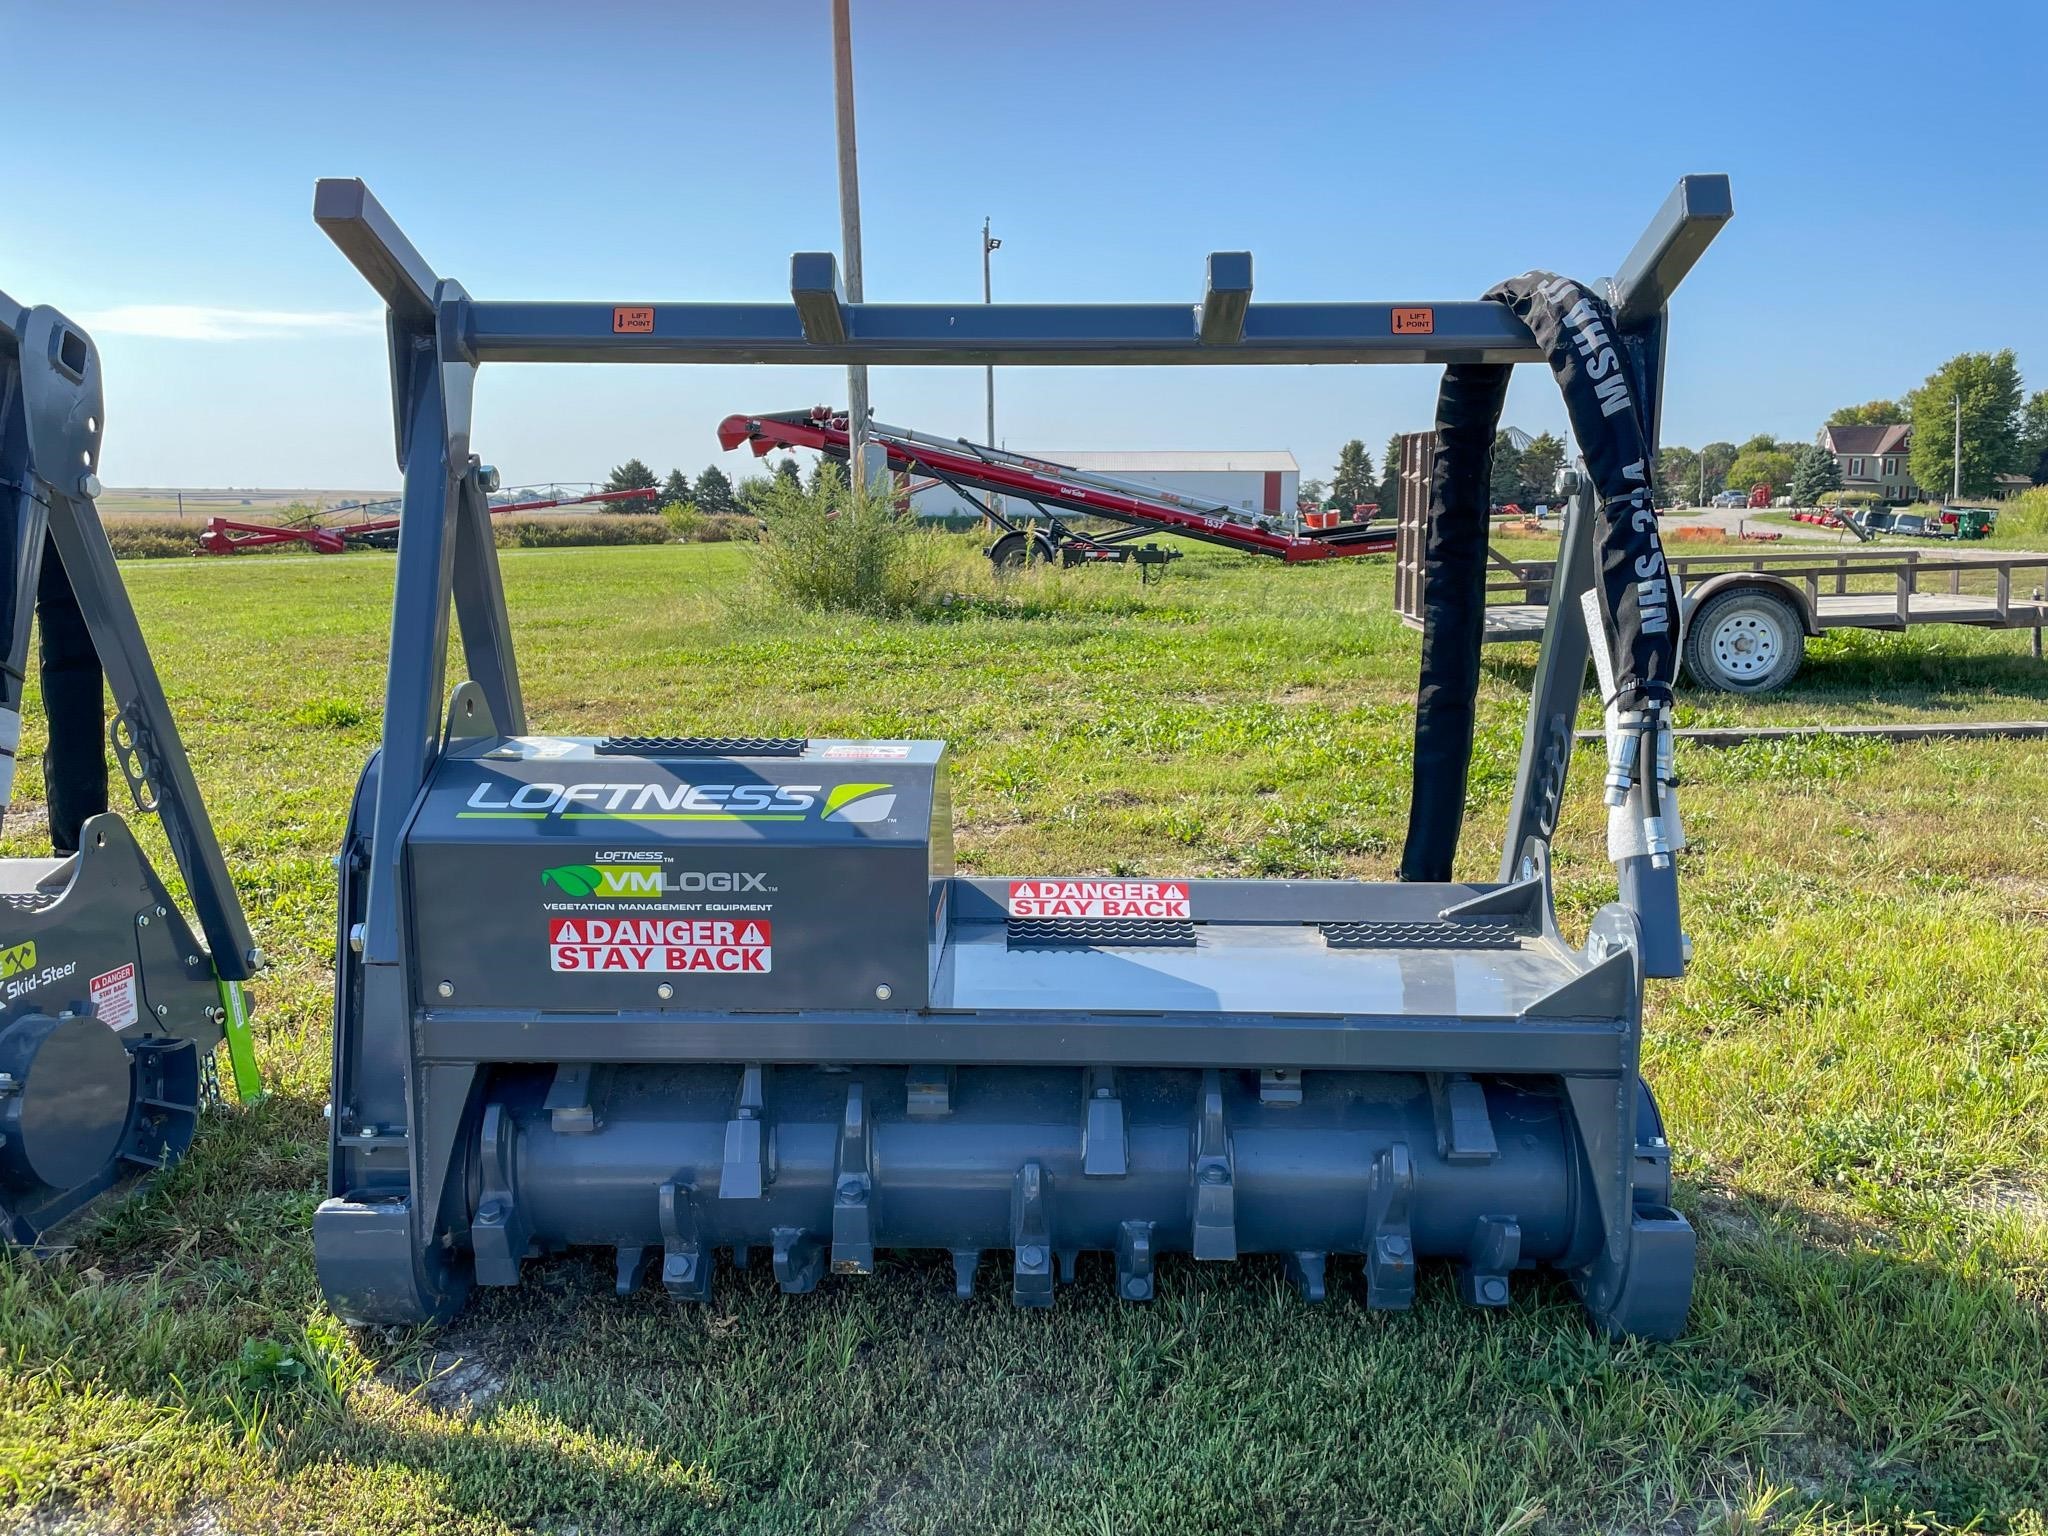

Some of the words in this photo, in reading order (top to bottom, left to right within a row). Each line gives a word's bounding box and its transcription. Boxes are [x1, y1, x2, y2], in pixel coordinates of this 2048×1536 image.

[1562, 298, 1632, 418] MSHA
[1203, 518, 1225, 530] 1537
[466, 782, 822, 814] LOFTNESS
[594, 851, 664, 861] LOFTNESS
[603, 871, 768, 892] VMLOGIX
[1039, 883, 1161, 899] DANGER
[543, 903, 615, 911] VEGETATION
[618, 903, 702, 911] MANAGEMENT
[1014, 900, 1093, 916] STAY
[1103, 901, 1185, 917] BACK
[586, 920, 735, 945] DANGER
[557, 946, 653, 970] STAY
[665, 948, 765, 971] BACK
[6, 961, 77, 1000] Skid-Steer
[101, 967, 131, 987] DANGER
